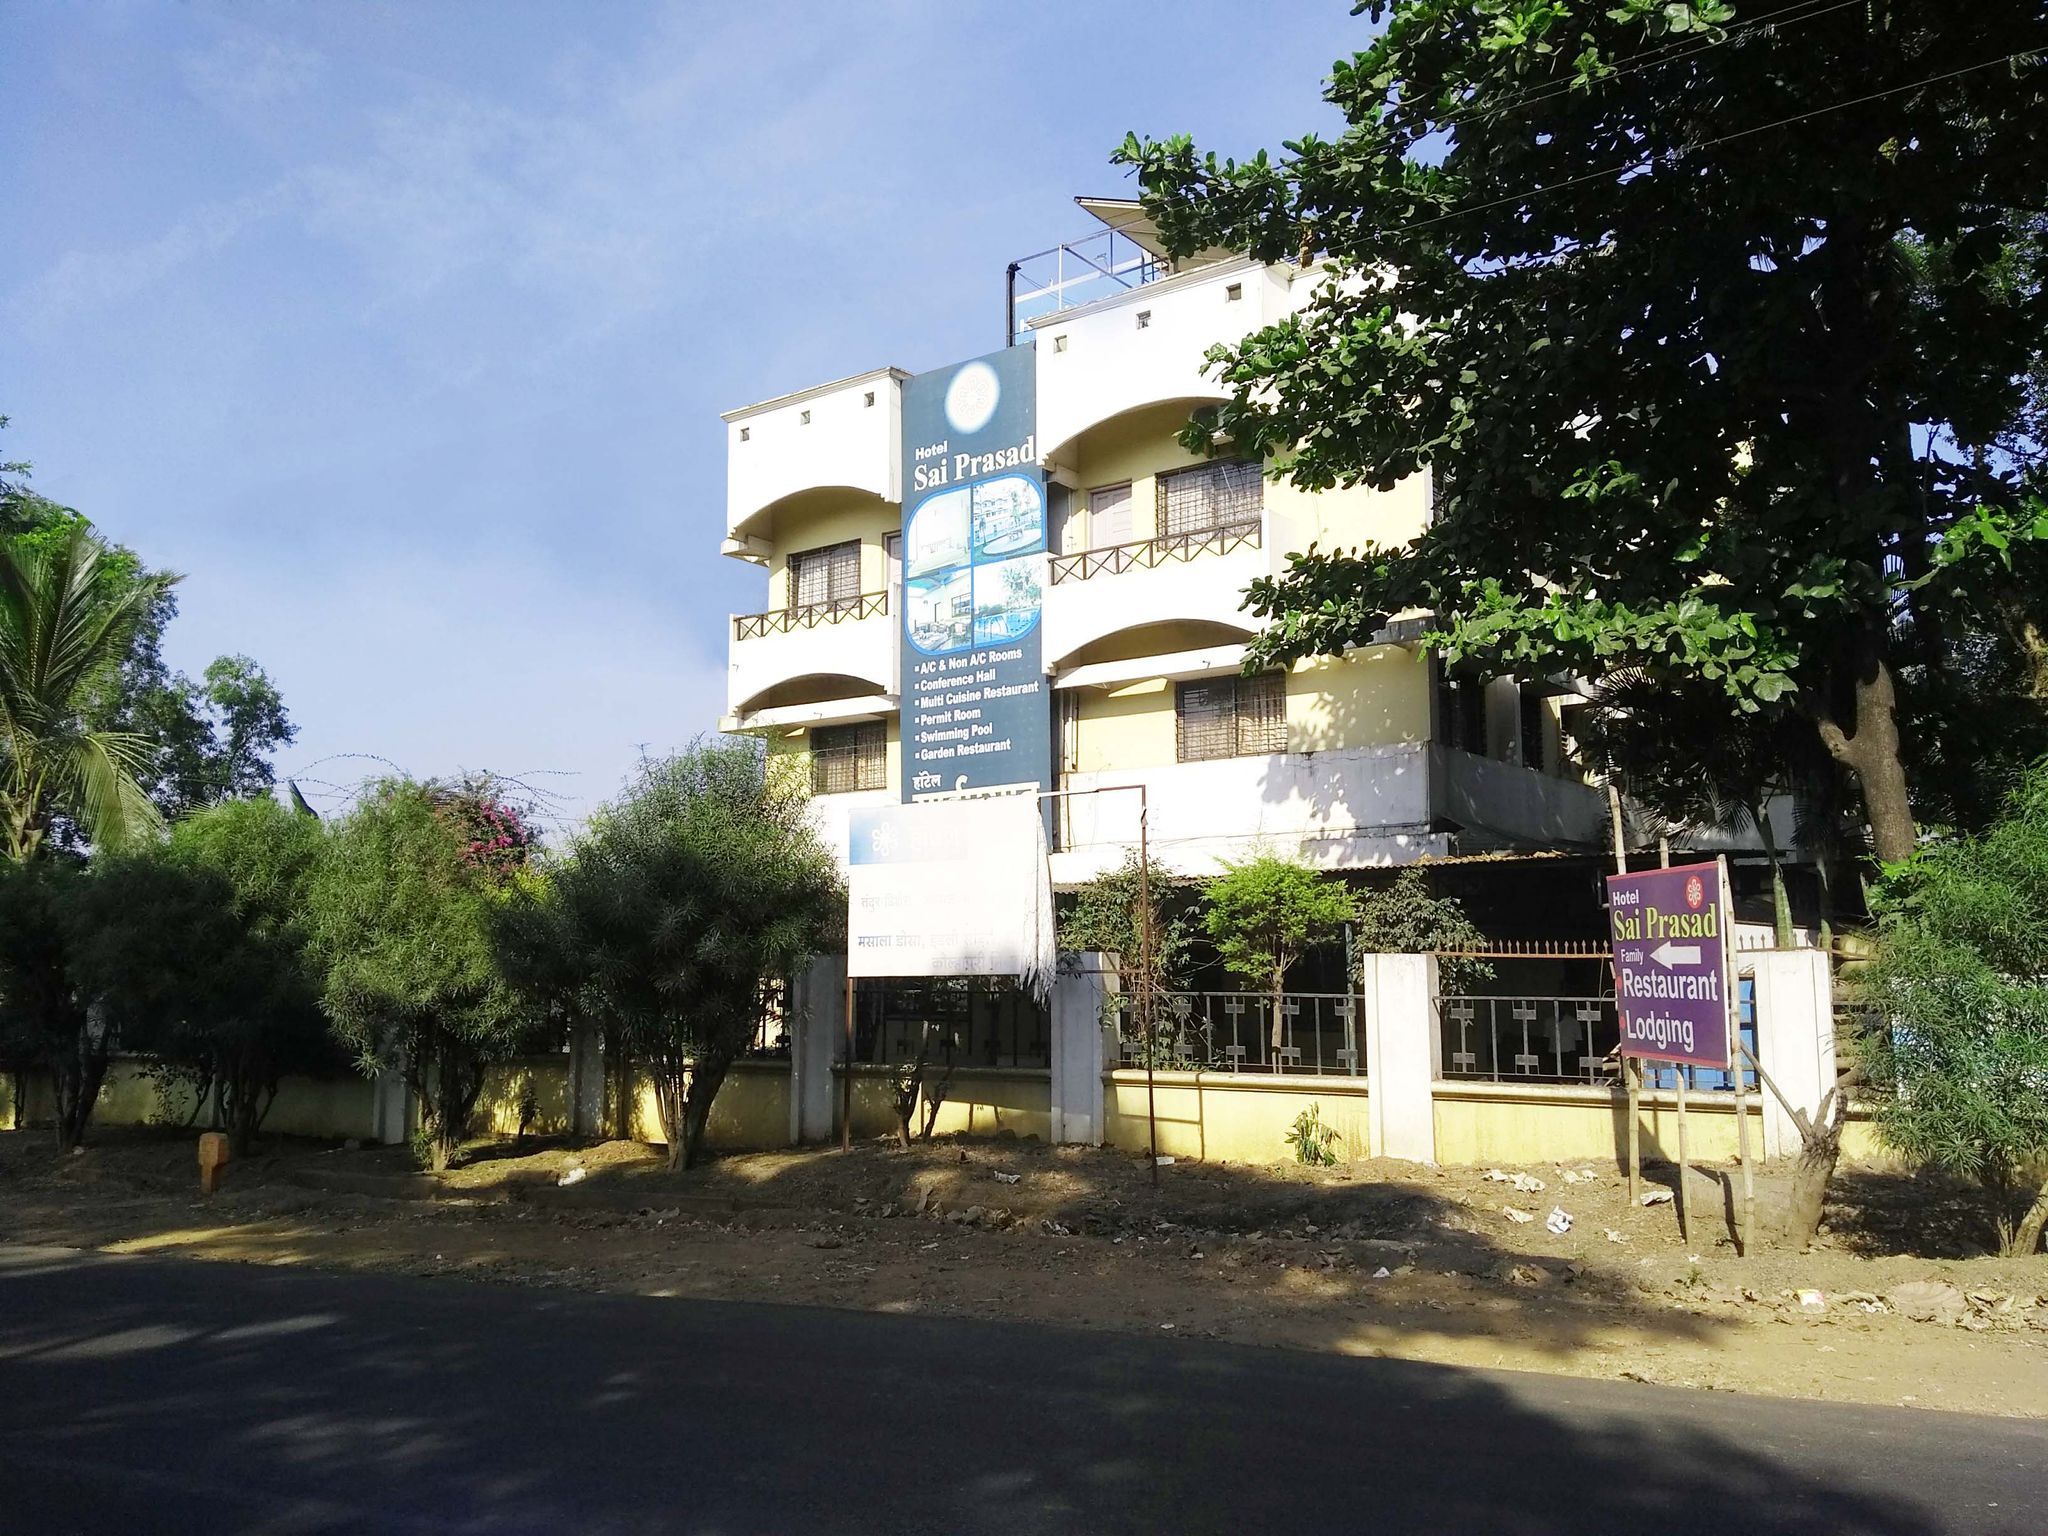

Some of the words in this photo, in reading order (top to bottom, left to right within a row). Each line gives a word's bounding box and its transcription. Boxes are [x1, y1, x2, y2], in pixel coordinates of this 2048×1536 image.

[915, 440, 948, 461] Hotel
[914, 458, 948, 492] Sai
[954, 435, 1036, 480] Prasad
[920, 661, 937, 674] A/C
[939, 659, 947, 671] &
[949, 657, 968, 670] Non
[970, 652, 987, 666] A/C
[988, 649, 1023, 663] Rooms
[920, 673, 974, 691] Conference
[976, 668, 996, 682] Hall
[920, 694, 944, 708] Multi
[946, 688, 982, 704] Cuisine
[983, 680, 1039, 700] Restaurant
[920, 711, 952, 726] Permit
[954, 708, 981, 722] Room
[920, 726, 969, 744] Swimming
[971, 722, 993, 736] Pool
[920, 746, 955, 761] Garden
[957, 738, 1011, 756] Restaurant
[912, 770, 942, 790] हॉटेल
[1612, 889, 1640, 906] Hotel
[1613, 907, 1642, 942] Sai
[1645, 903, 1718, 940] Prasad
[858, 935, 892, 948] मसाला
[1620, 948, 1644, 966] Family
[1622, 968, 1718, 1002] Restaurant
[1625, 1010, 1694, 1053] Lodging
